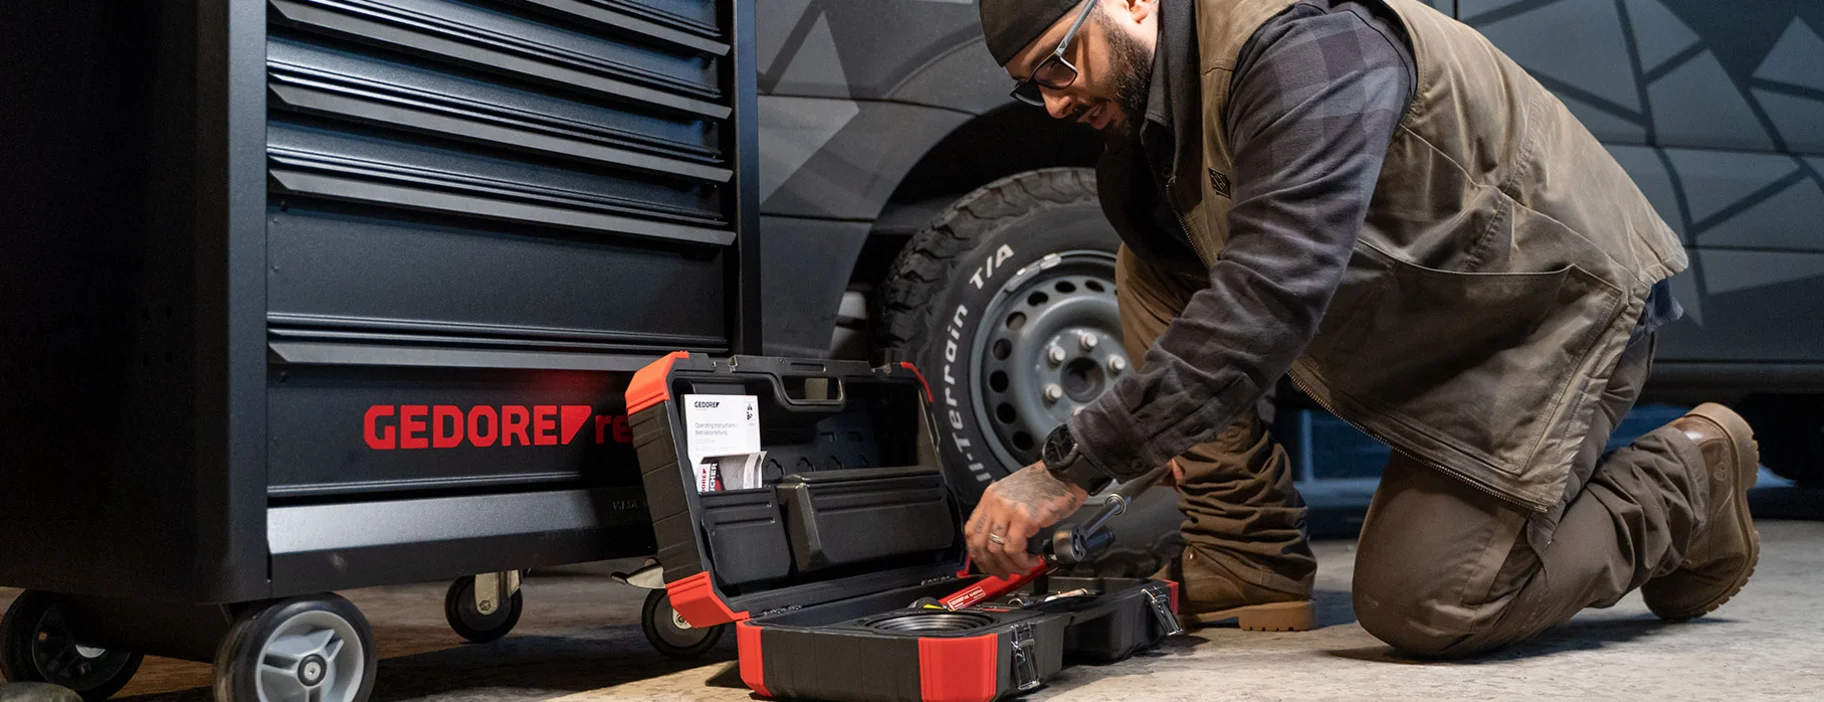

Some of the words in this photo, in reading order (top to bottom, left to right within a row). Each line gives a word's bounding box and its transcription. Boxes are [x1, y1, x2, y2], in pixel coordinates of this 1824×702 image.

[969, 243, 1015, 290] T/A
[944, 303, 996, 483] ll-Terrain
[363, 405, 558, 450] GEDORE
